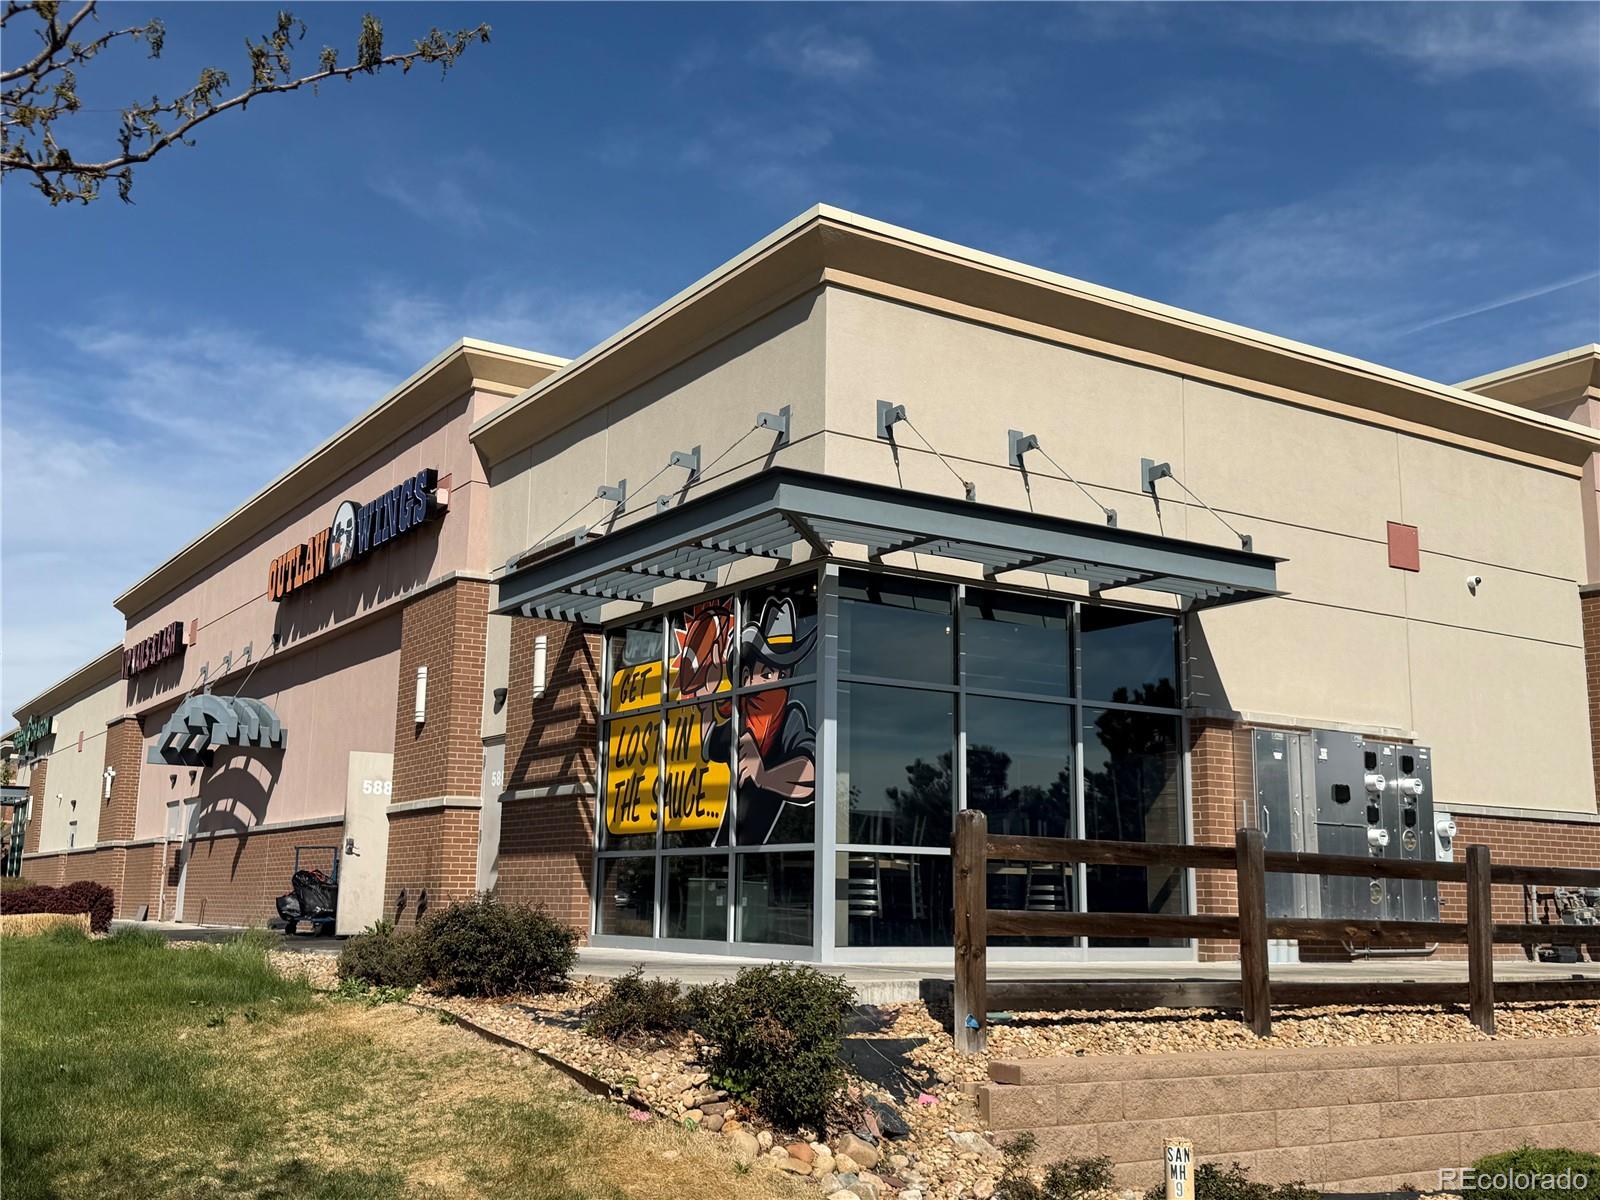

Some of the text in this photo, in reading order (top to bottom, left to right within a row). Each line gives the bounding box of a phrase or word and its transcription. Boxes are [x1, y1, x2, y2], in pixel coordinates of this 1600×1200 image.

[268, 469, 430, 602] OUTLAW WINGS
[131, 638, 150, 675] NAILS
[157, 622, 177, 662] LASH
[620, 667, 652, 704] GET
[615, 714, 694, 768] LOST IN
[362, 779, 392, 795] 588
[613, 767, 719, 822] THE SAUCE...
[1167, 1147, 1190, 1162] SAN
[1170, 1164, 1186, 1180] MH
[1176, 1182, 1183, 1197] 9
